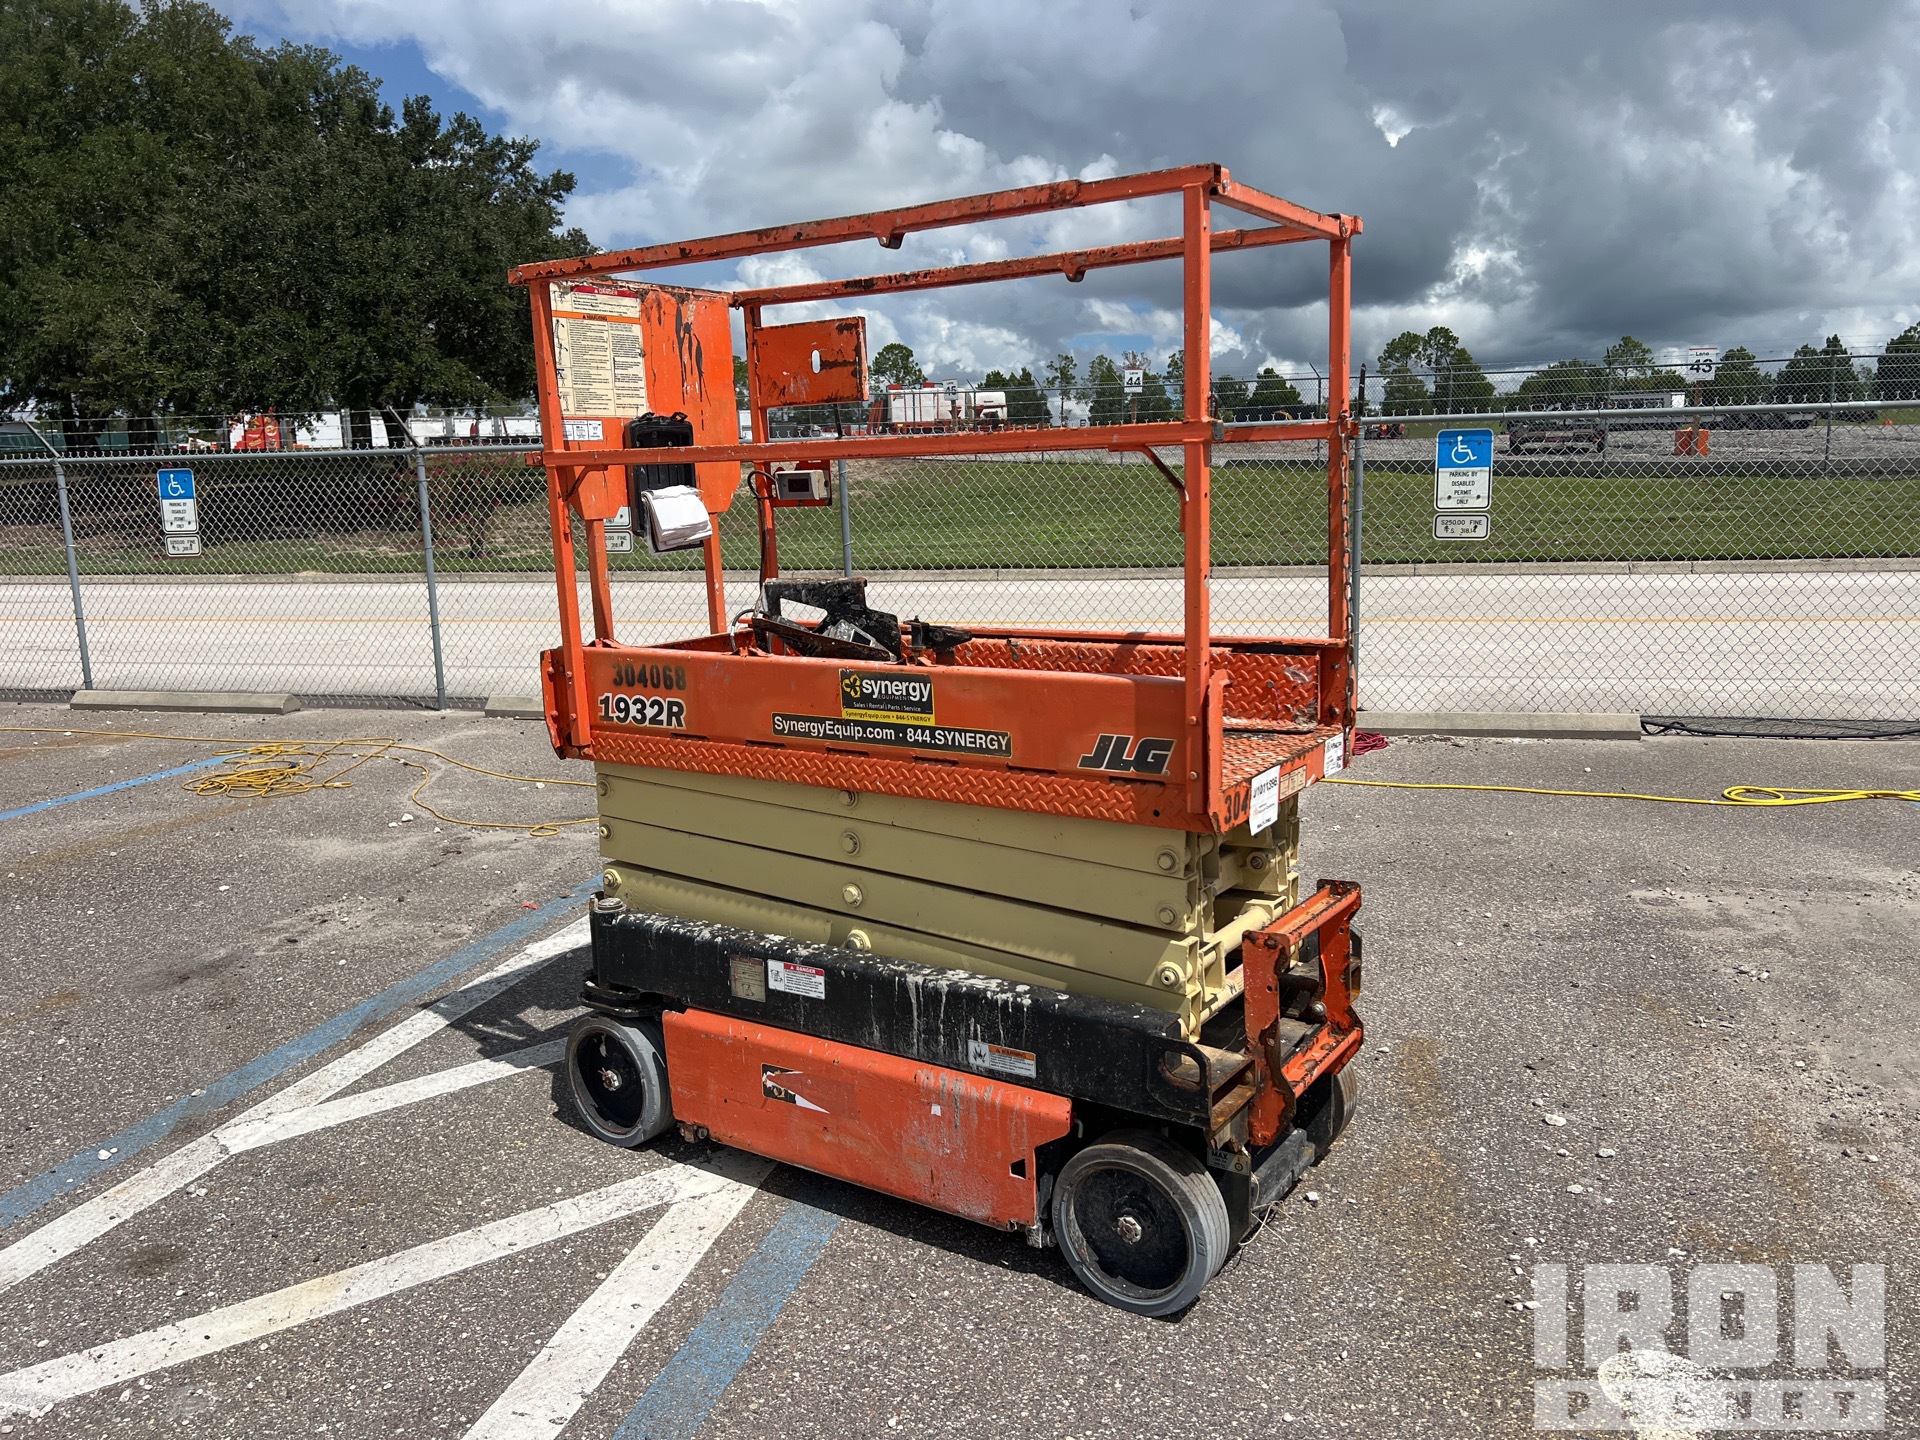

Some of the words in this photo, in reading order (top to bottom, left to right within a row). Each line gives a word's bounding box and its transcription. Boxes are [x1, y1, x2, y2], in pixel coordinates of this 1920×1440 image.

[599, 288, 618, 296] DANGER
[1690, 358, 1713, 373] 43
[1126, 376, 1141, 386] 44
[612, 662, 686, 690] 304068
[862, 679, 931, 702] synergy
[598, 693, 686, 729] 1932R
[868, 702, 885, 710] Rental
[845, 710, 891, 720] SynergyEquip.com
[774, 716, 895, 741] SynergyEquip.com
[906, 727, 1009, 751] 844.SYNERGY
[1077, 733, 1176, 775] JLG
[796, 966, 816, 974] DANGER
[1211, 1150, 1228, 1160] MAX
